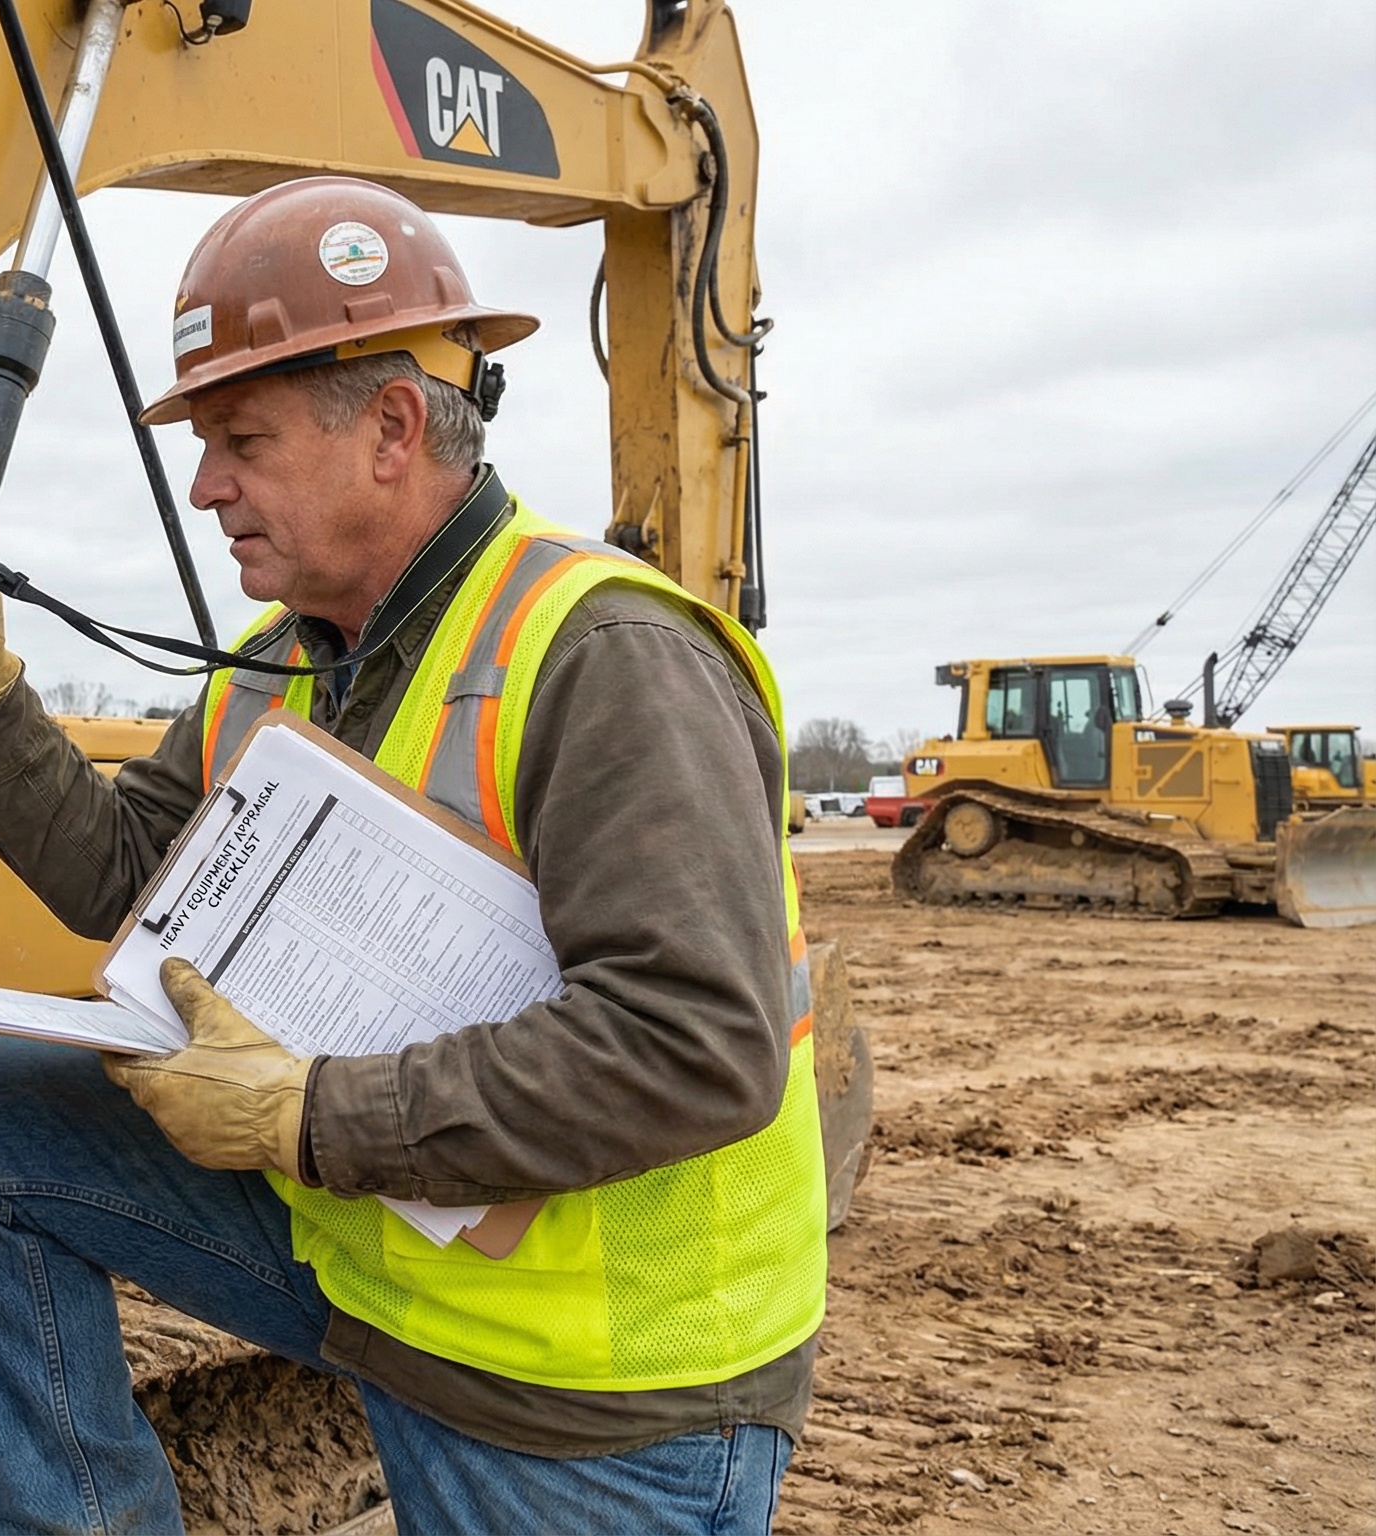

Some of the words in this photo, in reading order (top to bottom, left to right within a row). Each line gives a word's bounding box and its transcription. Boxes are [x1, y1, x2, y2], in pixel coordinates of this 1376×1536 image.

[426, 57, 503, 157] CAT
[160, 909, 190, 950] HEAVY
[187, 840, 236, 910] EQUIPMENT
[234, 781, 279, 842] APPRAISAL
[208, 831, 260, 908] CHECKLIST
